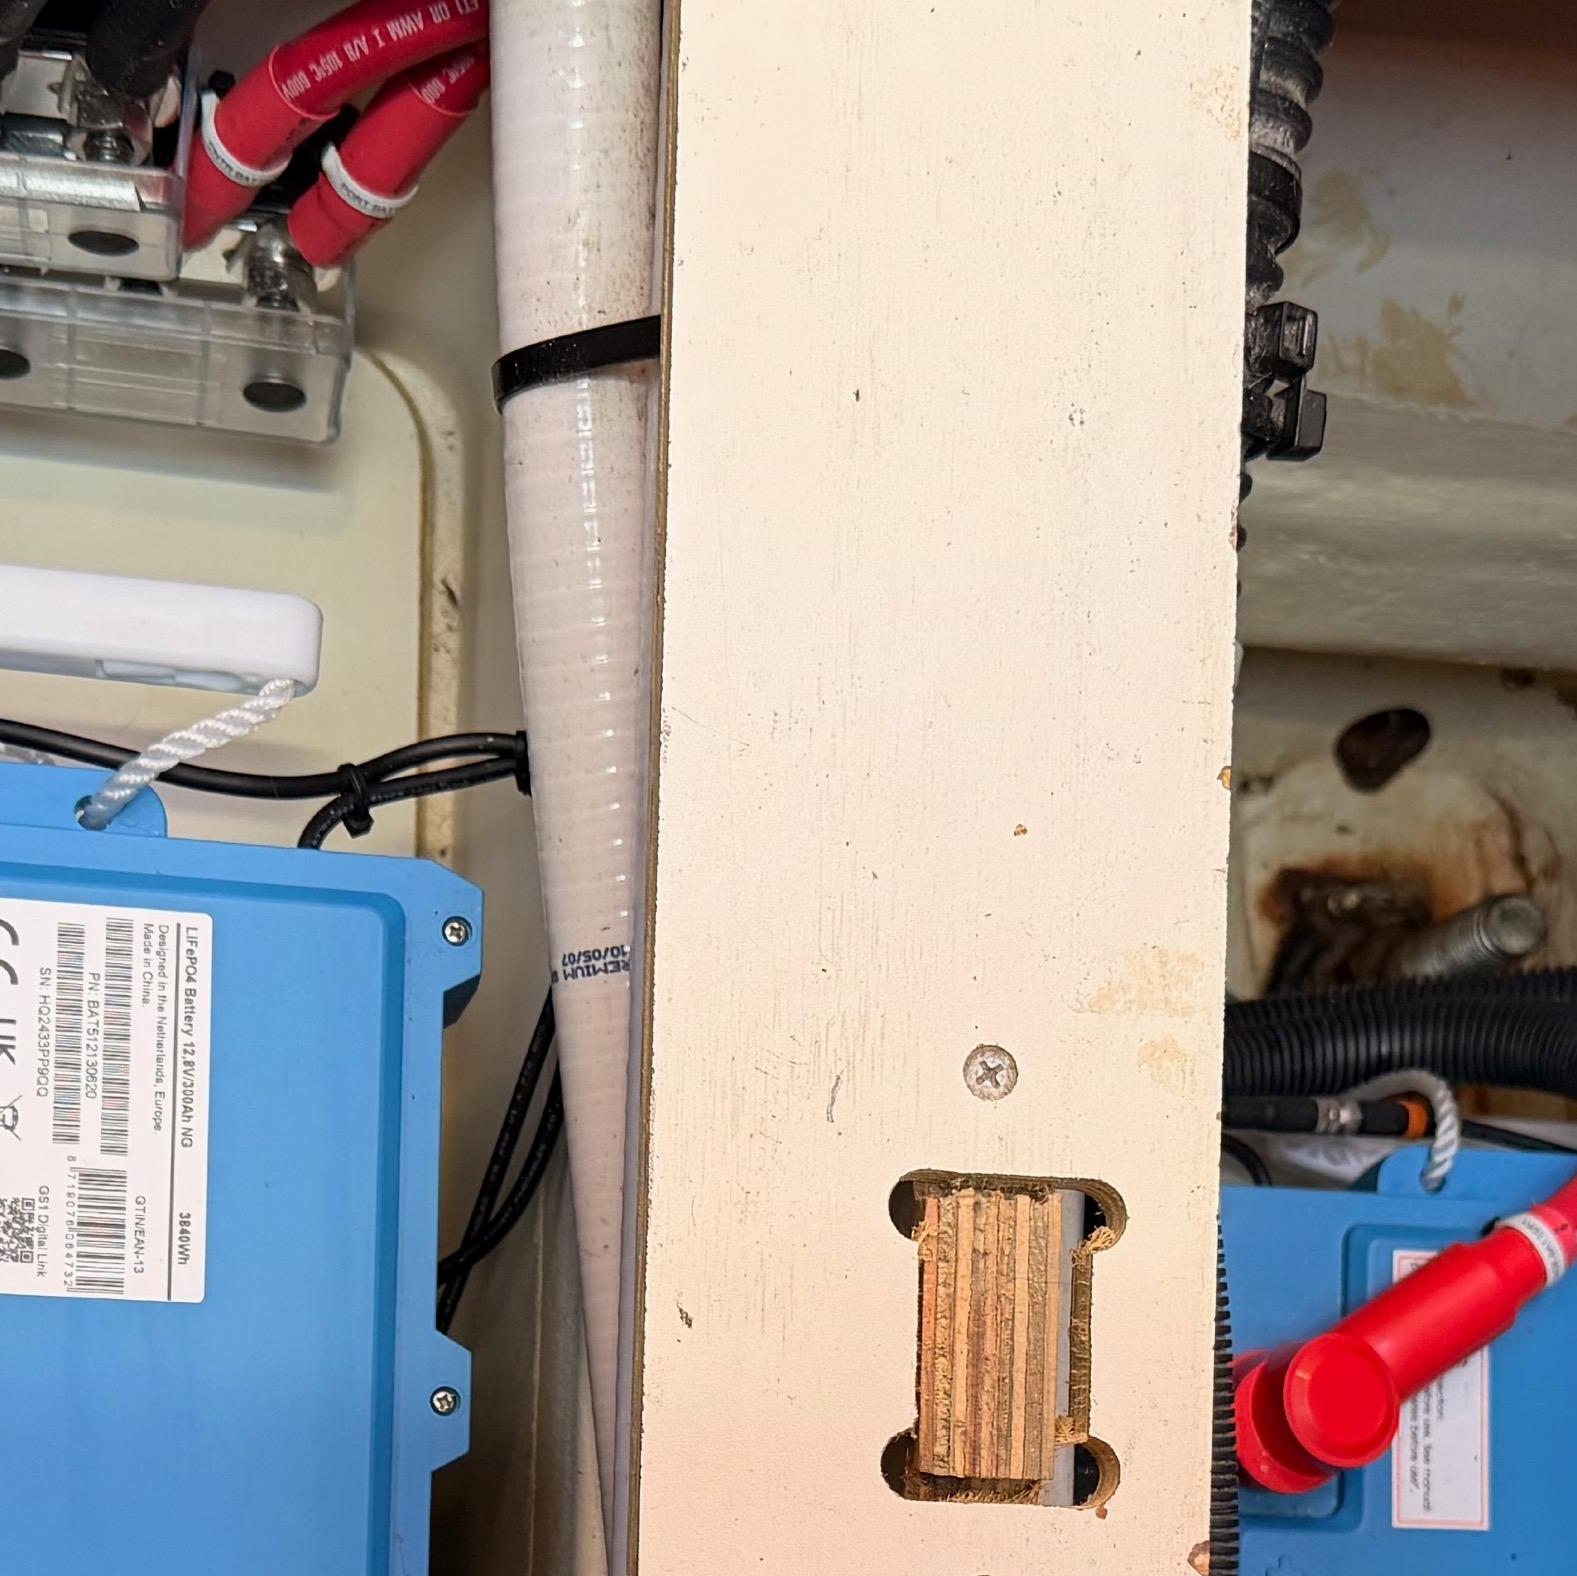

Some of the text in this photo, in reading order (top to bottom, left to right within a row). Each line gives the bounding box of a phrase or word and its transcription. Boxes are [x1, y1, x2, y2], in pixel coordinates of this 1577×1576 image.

[386, 11, 424, 42] AWM
[141, 922, 155, 1008] Made in China.
[155, 924, 170, 980] Designed
[185, 925, 199, 984] LiFePO4
[561, 944, 628, 967] 10/05/07
[562, 958, 631, 982] REMIUM
[156, 994, 168, 1013] the
[157, 981, 168, 992] in
[180, 987, 198, 1035] Battery
[36, 966, 53, 1097] SN: HQ2433PP9QQ
[84, 971, 102, 1099] PN: BAT512130620
[153, 1015, 167, 1088] Netherlands,
[180, 1129, 195, 1149] NG
[35, 1184, 50, 1278] GS1 Digital Link
[133, 1194, 147, 1274] GTIN/EAN-13
[177, 1211, 192, 1265] 3840Wh
